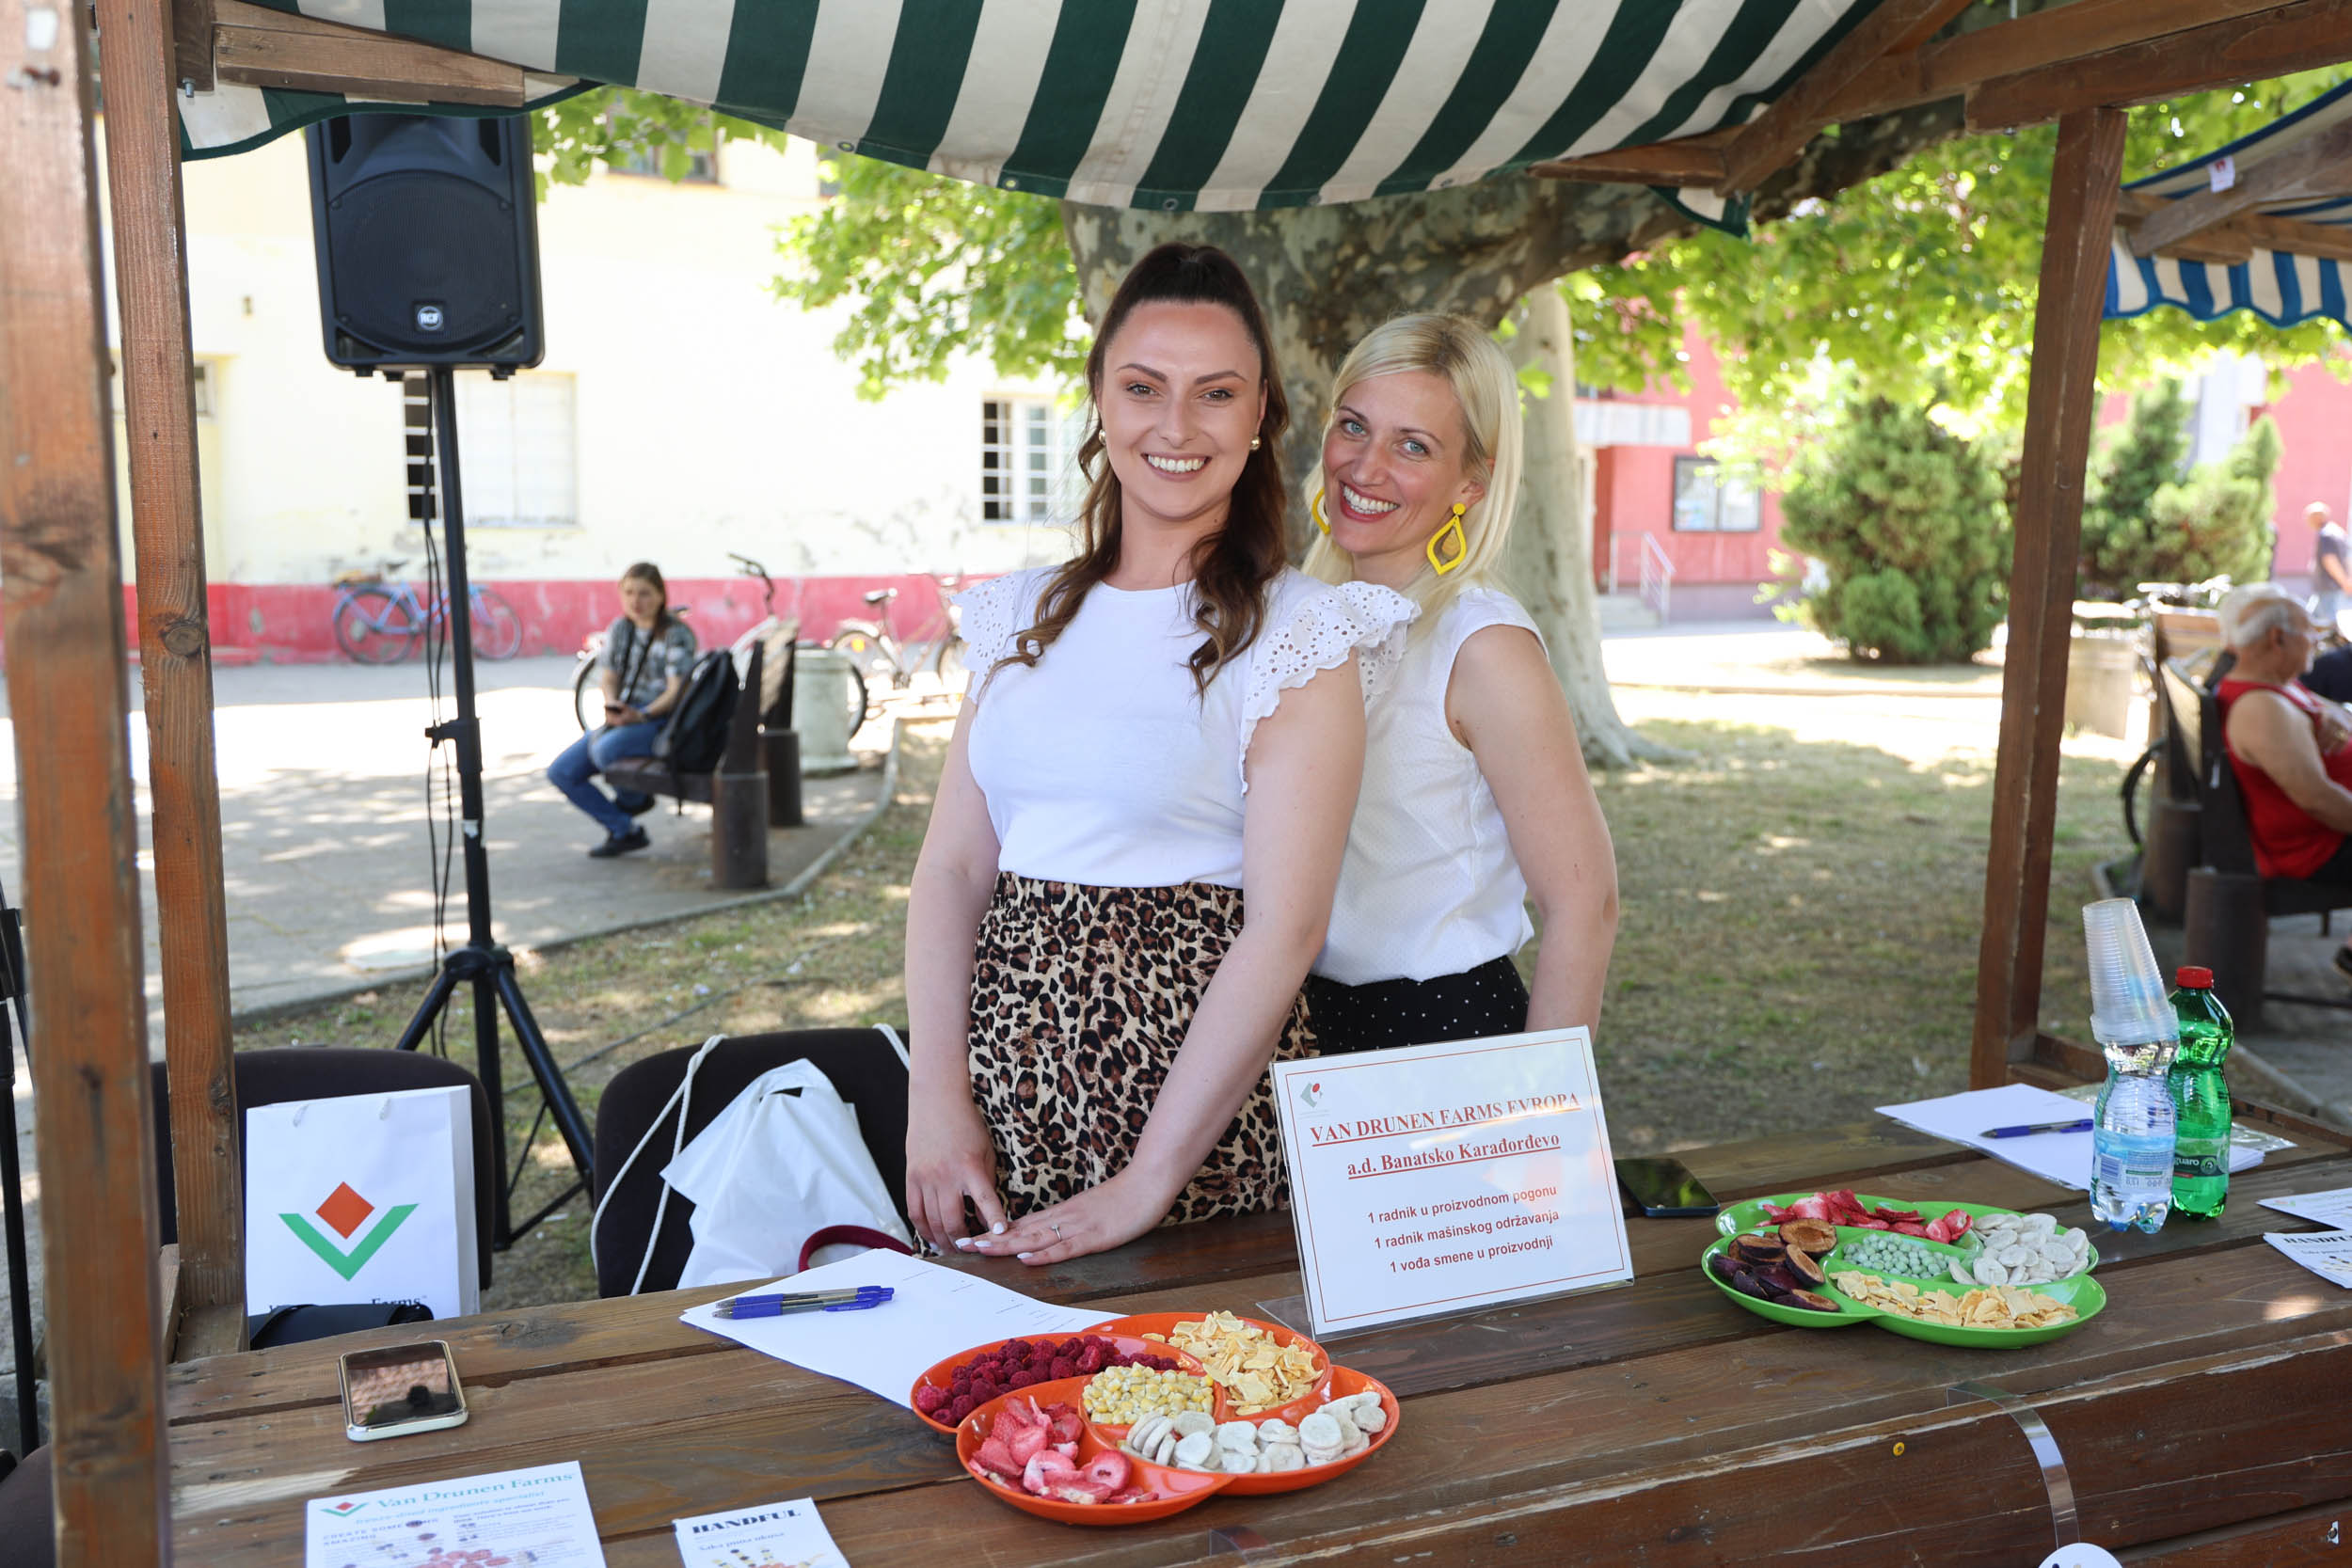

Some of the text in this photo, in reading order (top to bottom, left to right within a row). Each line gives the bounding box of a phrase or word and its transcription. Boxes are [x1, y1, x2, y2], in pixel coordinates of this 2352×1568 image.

[1310, 1122, 1351, 1142] VAN
[1357, 1111, 1436, 1136] DRUNEN
[1439, 1102, 1503, 1125] FARMS
[1507, 1092, 1581, 1116] EVROPA
[1347, 1132, 1560, 1176] a.d. Banatsko Karađorđevo
[1368, 1185, 1558, 1225] 1 radnik u proizvodnom pogonu
[1375, 1210, 1560, 1249] 1 radnik mašinskog održavanja
[1390, 1235, 1554, 1273] 1 vođa smene u proizvodnji
[377, 1474, 573, 1508] Van Drunen Farms
[692, 1510, 802, 1533] HANDFUL
